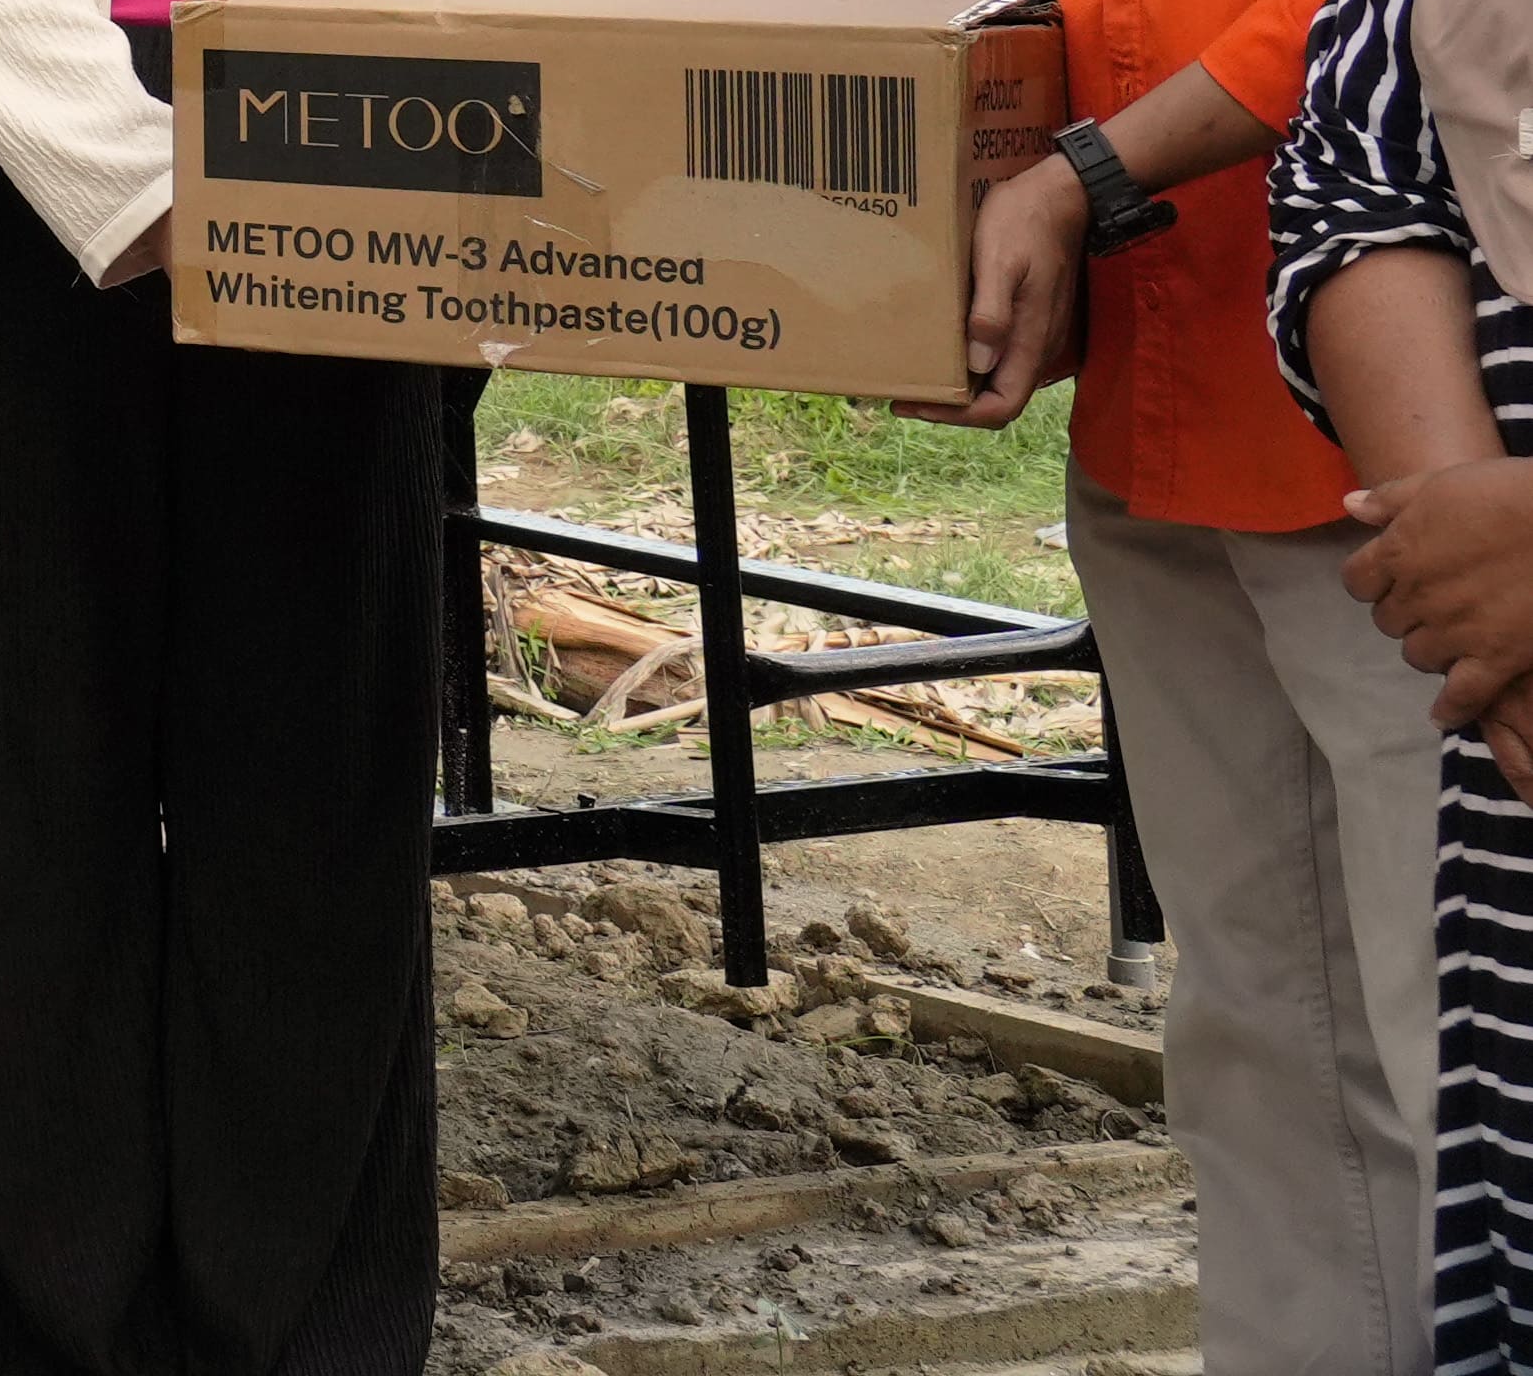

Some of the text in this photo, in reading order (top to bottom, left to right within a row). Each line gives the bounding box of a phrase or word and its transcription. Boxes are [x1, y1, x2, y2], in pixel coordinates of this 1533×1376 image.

[237, 88, 504, 155] METOO
[974, 79, 1024, 113] PRODUCT
[206, 219, 706, 286] METOO MW-3 Advanced
[205, 269, 783, 351] Whitening Toothpaste(100g)
